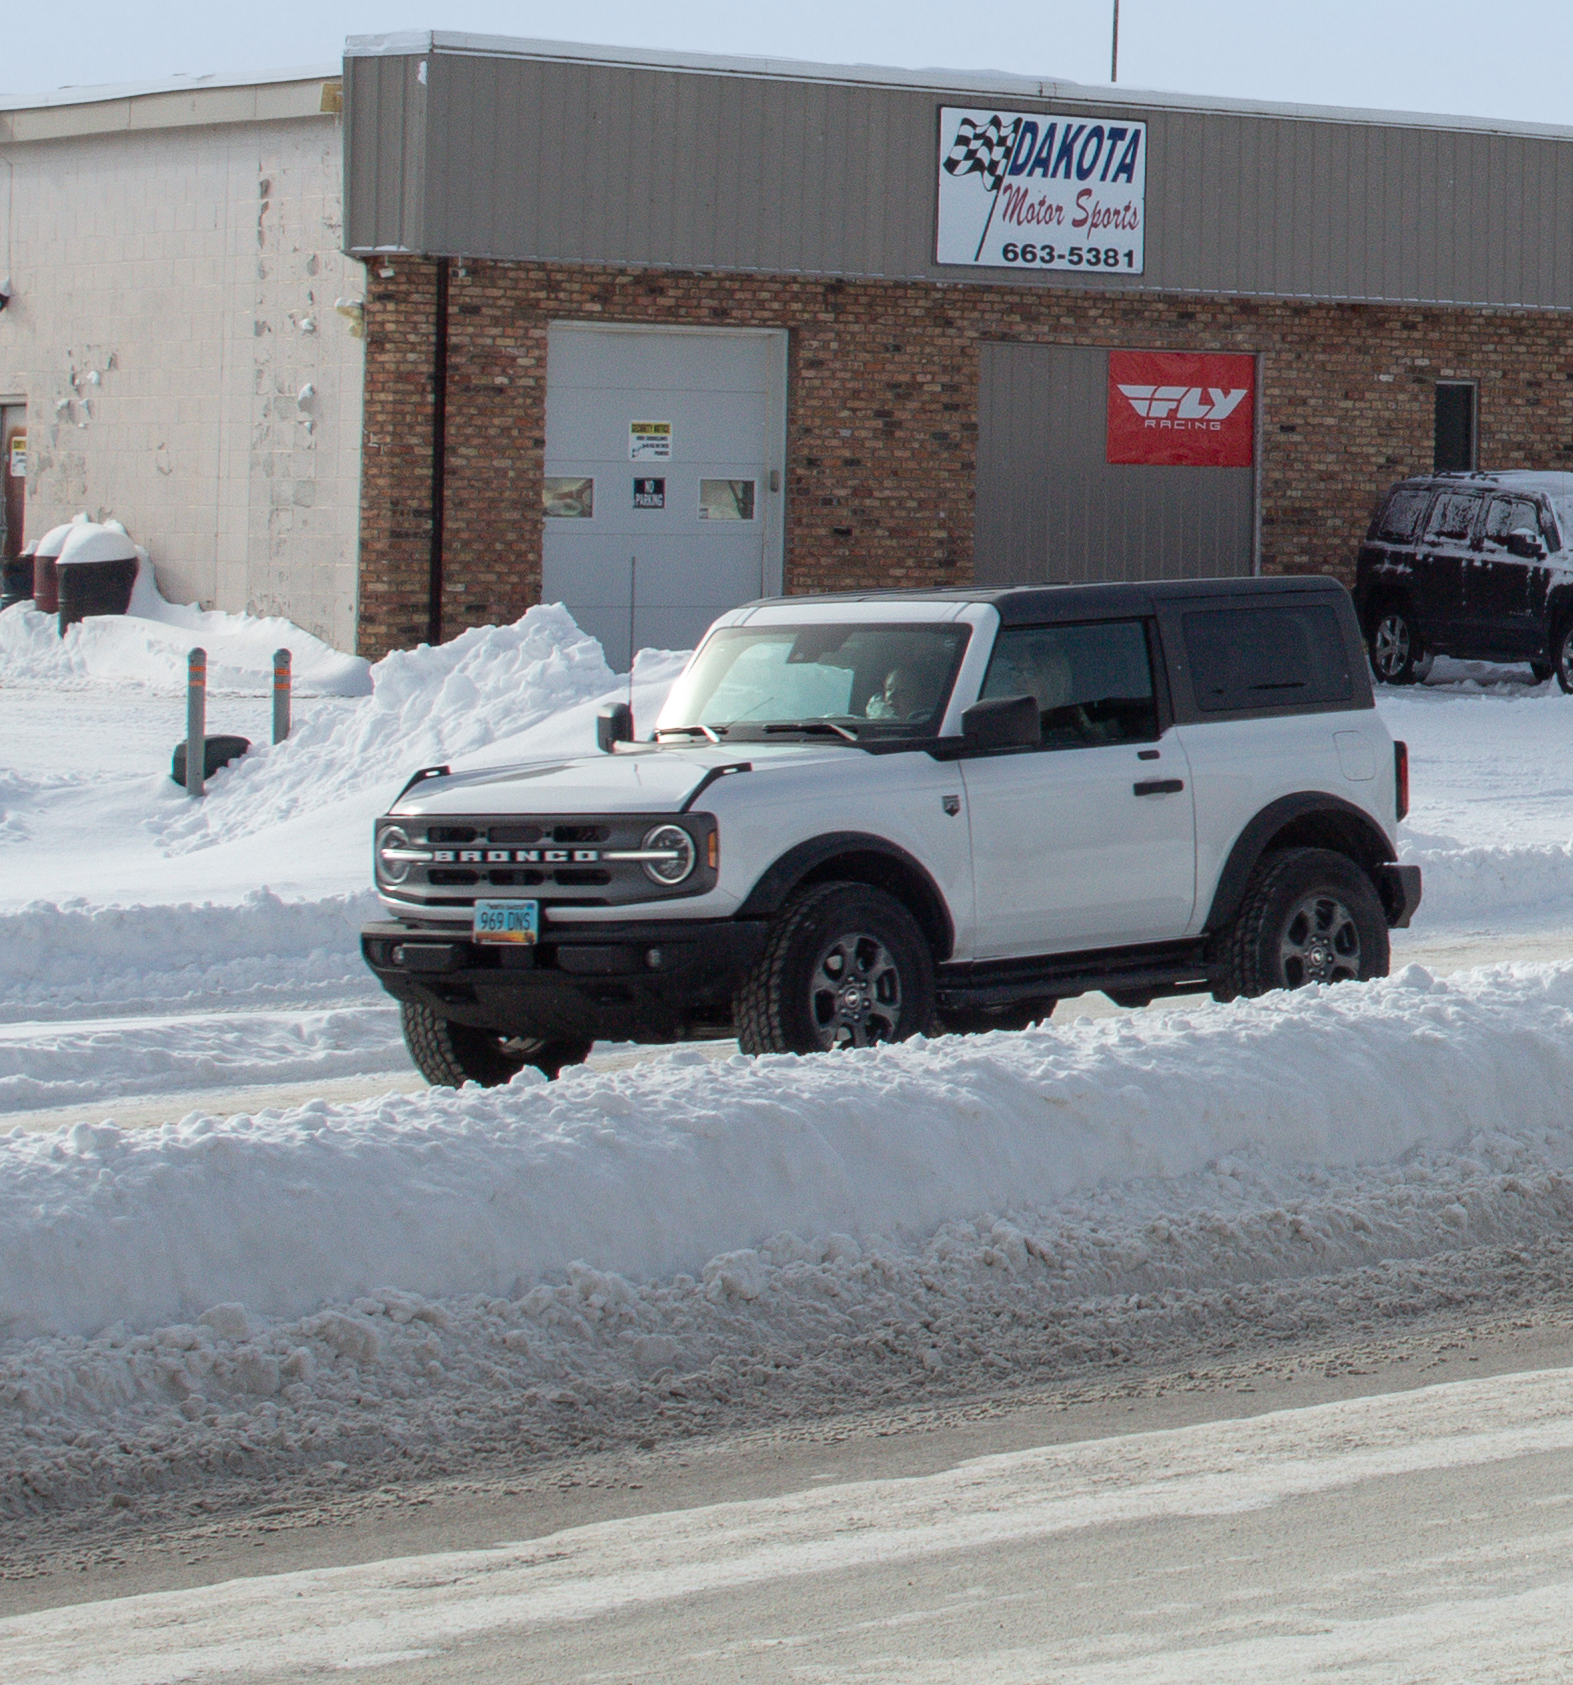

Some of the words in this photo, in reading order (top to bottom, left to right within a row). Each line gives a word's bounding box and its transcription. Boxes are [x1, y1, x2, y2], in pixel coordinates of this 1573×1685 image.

[1007, 120, 1142, 184] DAKOTA
[1002, 182, 1064, 226] Motor
[1071, 188, 1140, 240] Sports
[1002, 242, 1134, 268] 663-5381
[1116, 383, 1249, 420] FLY
[1144, 419, 1221, 431] RACING
[434, 850, 598, 862] BRONCO
[481, 912, 504, 930] 969
[508, 912, 531, 930] DNS
